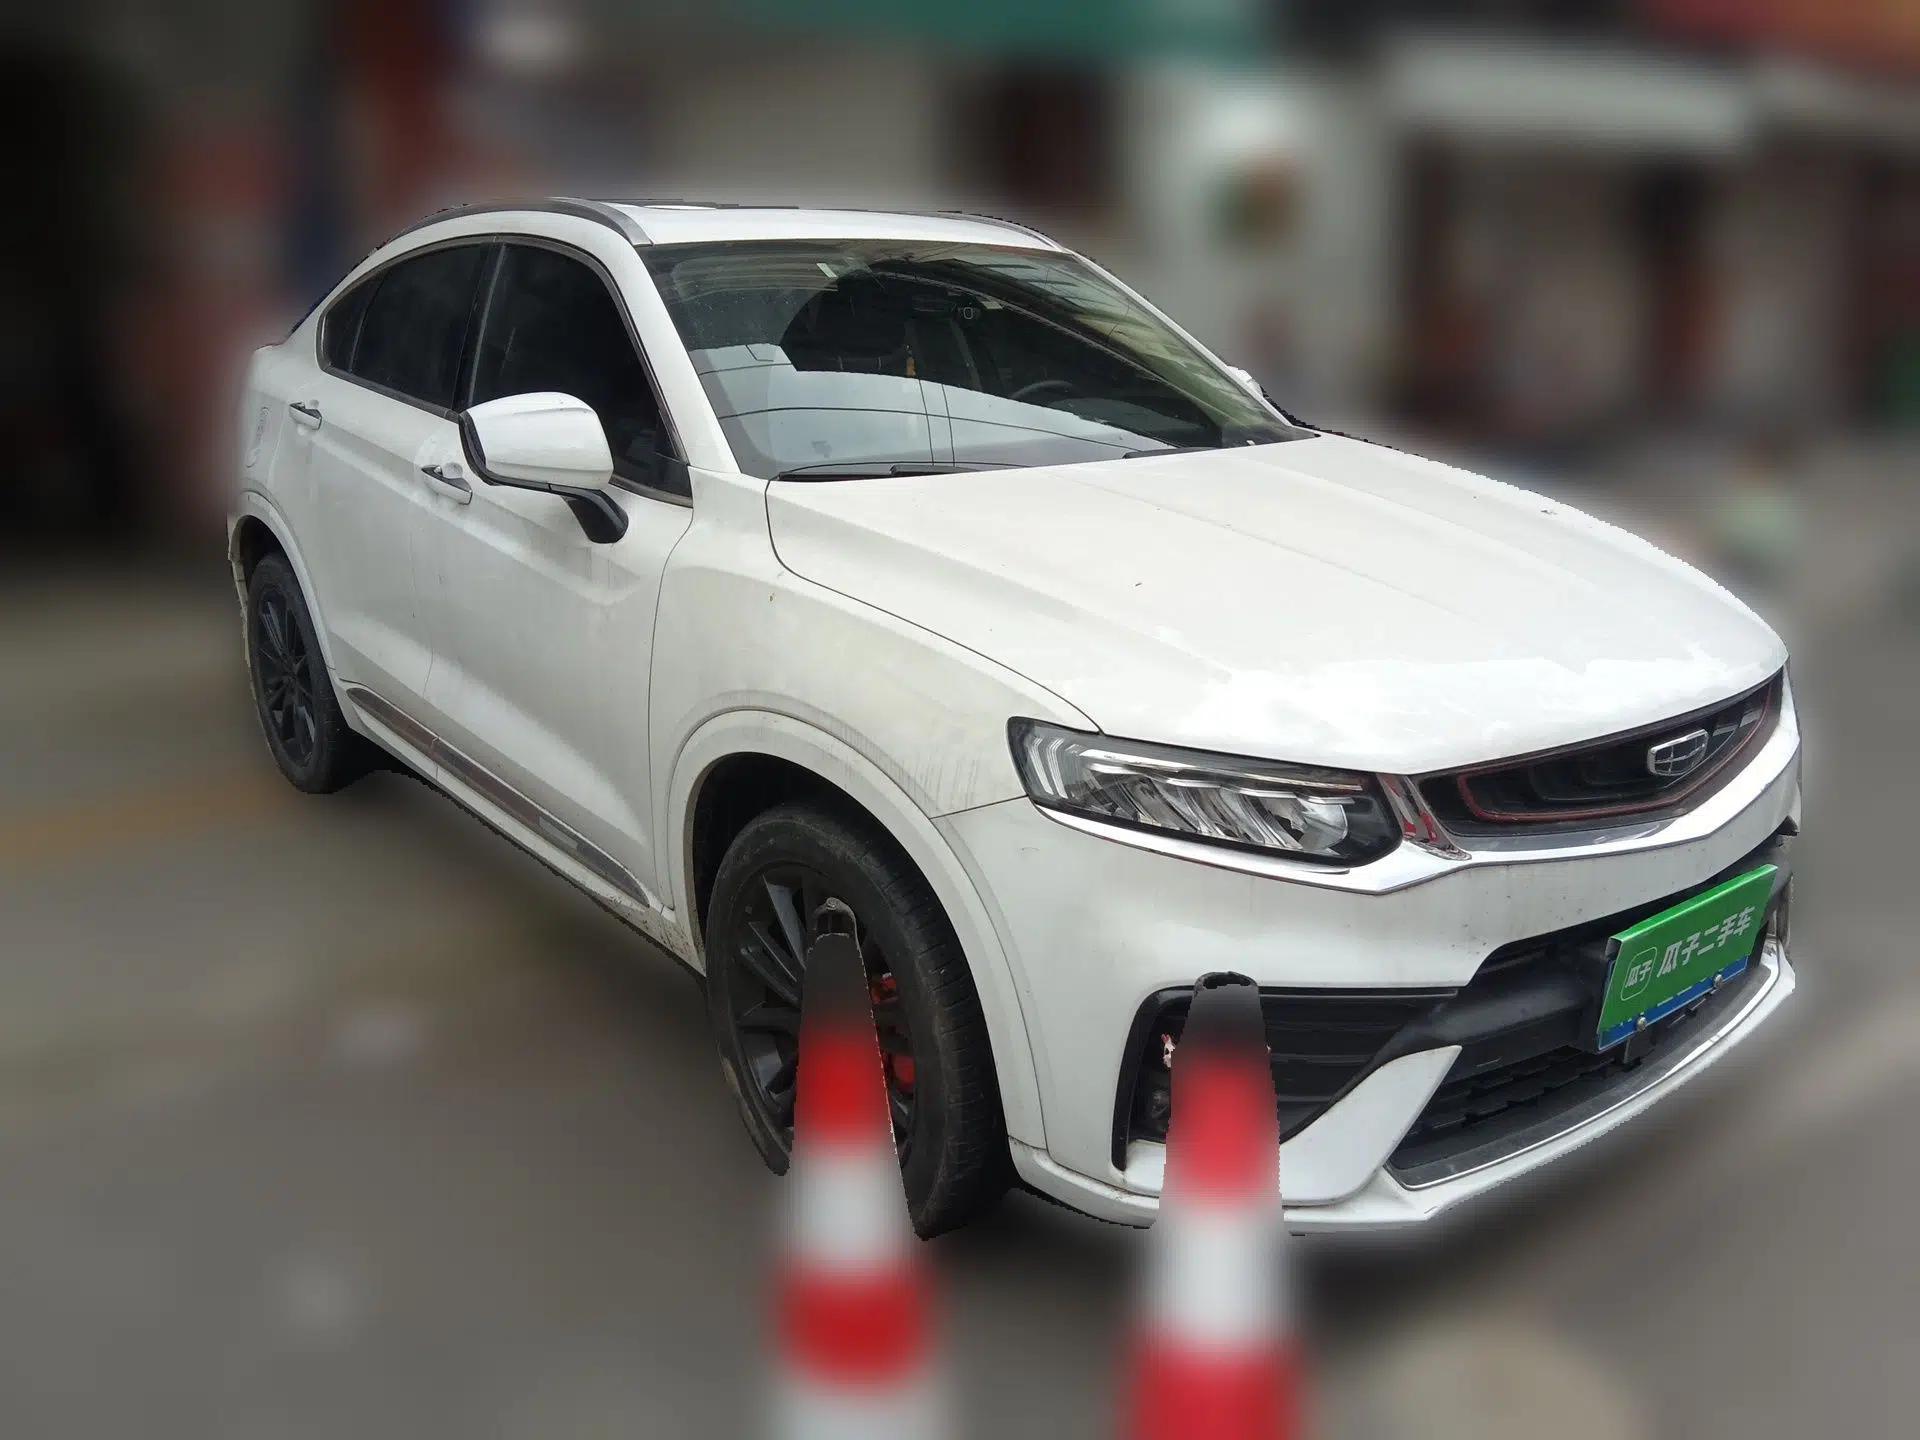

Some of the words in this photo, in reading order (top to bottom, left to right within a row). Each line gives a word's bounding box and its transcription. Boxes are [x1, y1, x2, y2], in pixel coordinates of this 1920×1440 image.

[1657, 907, 1755, 977] 瓜子二手车
[1625, 959, 1653, 988] 瓜子
